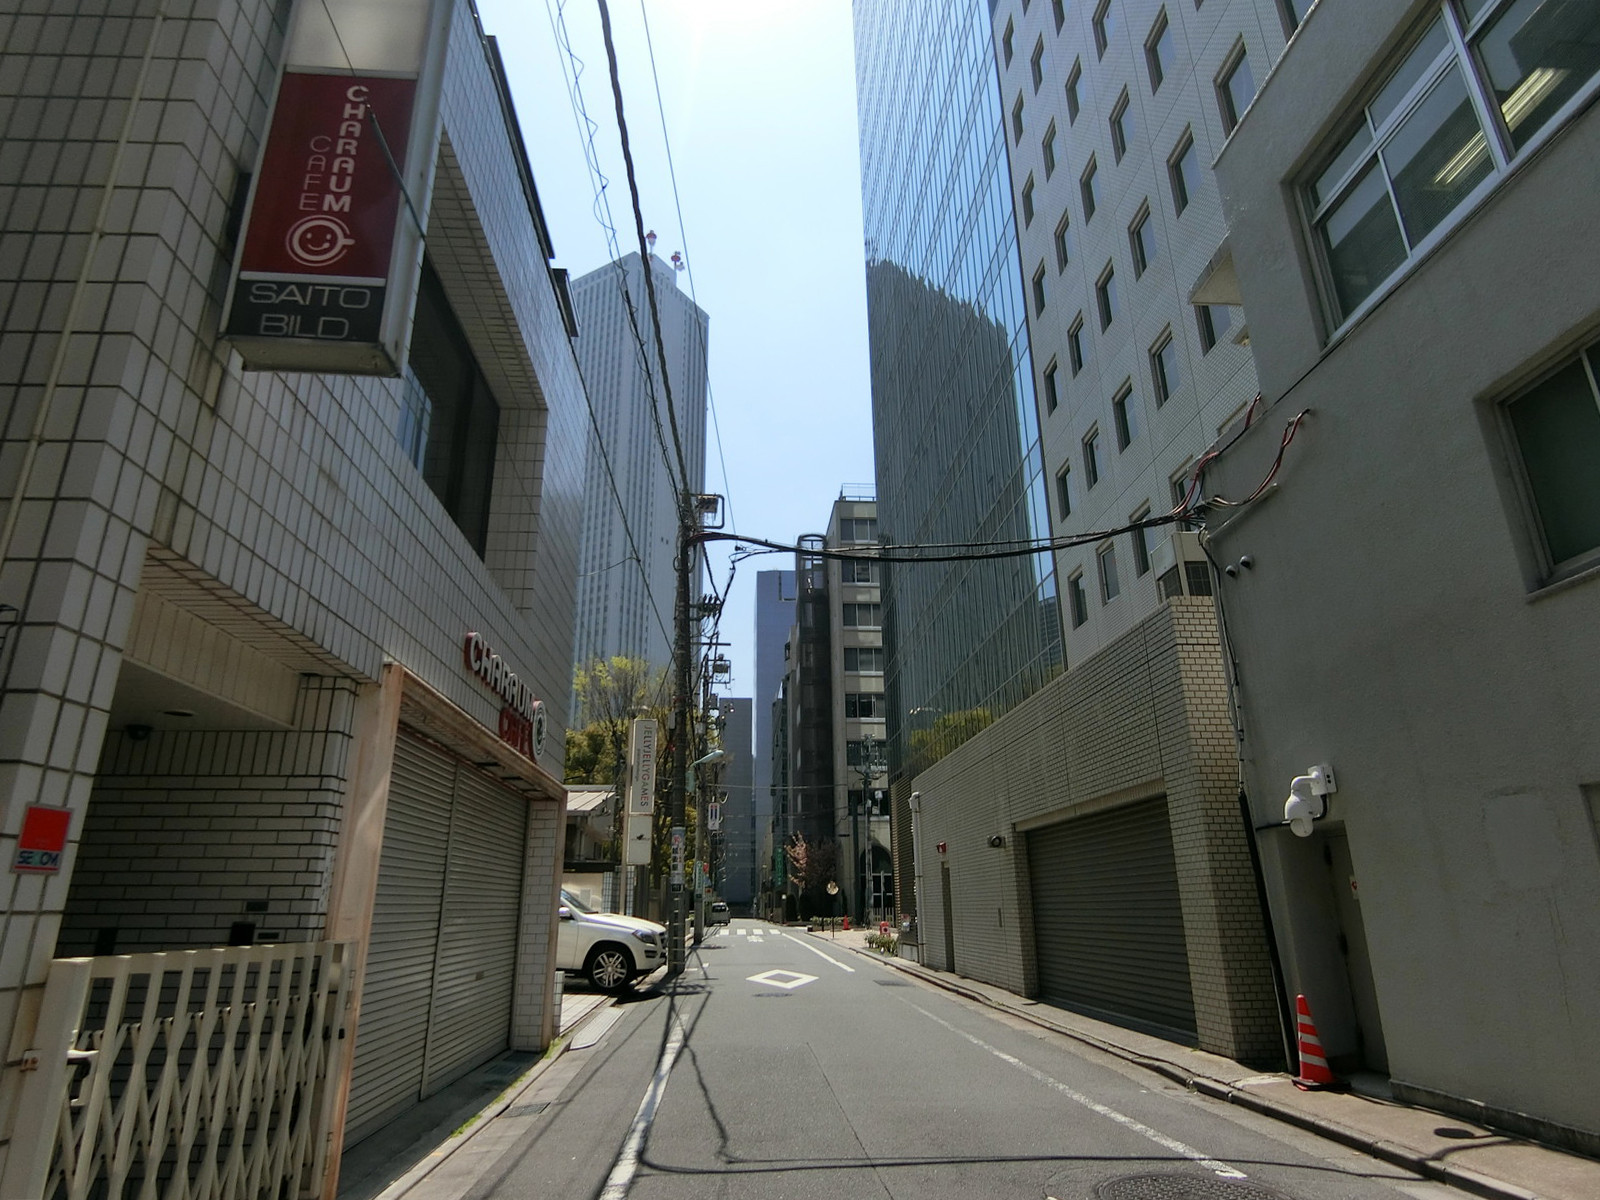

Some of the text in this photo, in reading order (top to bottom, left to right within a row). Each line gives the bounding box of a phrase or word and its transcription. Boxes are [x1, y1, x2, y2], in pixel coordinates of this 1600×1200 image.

[299, 135, 332, 212] CAFE
[322, 84, 370, 213] CHARAUM
[249, 282, 372, 309] SAITO
[259, 313, 350, 340] BILD
[464, 631, 535, 723] CHARAUM
